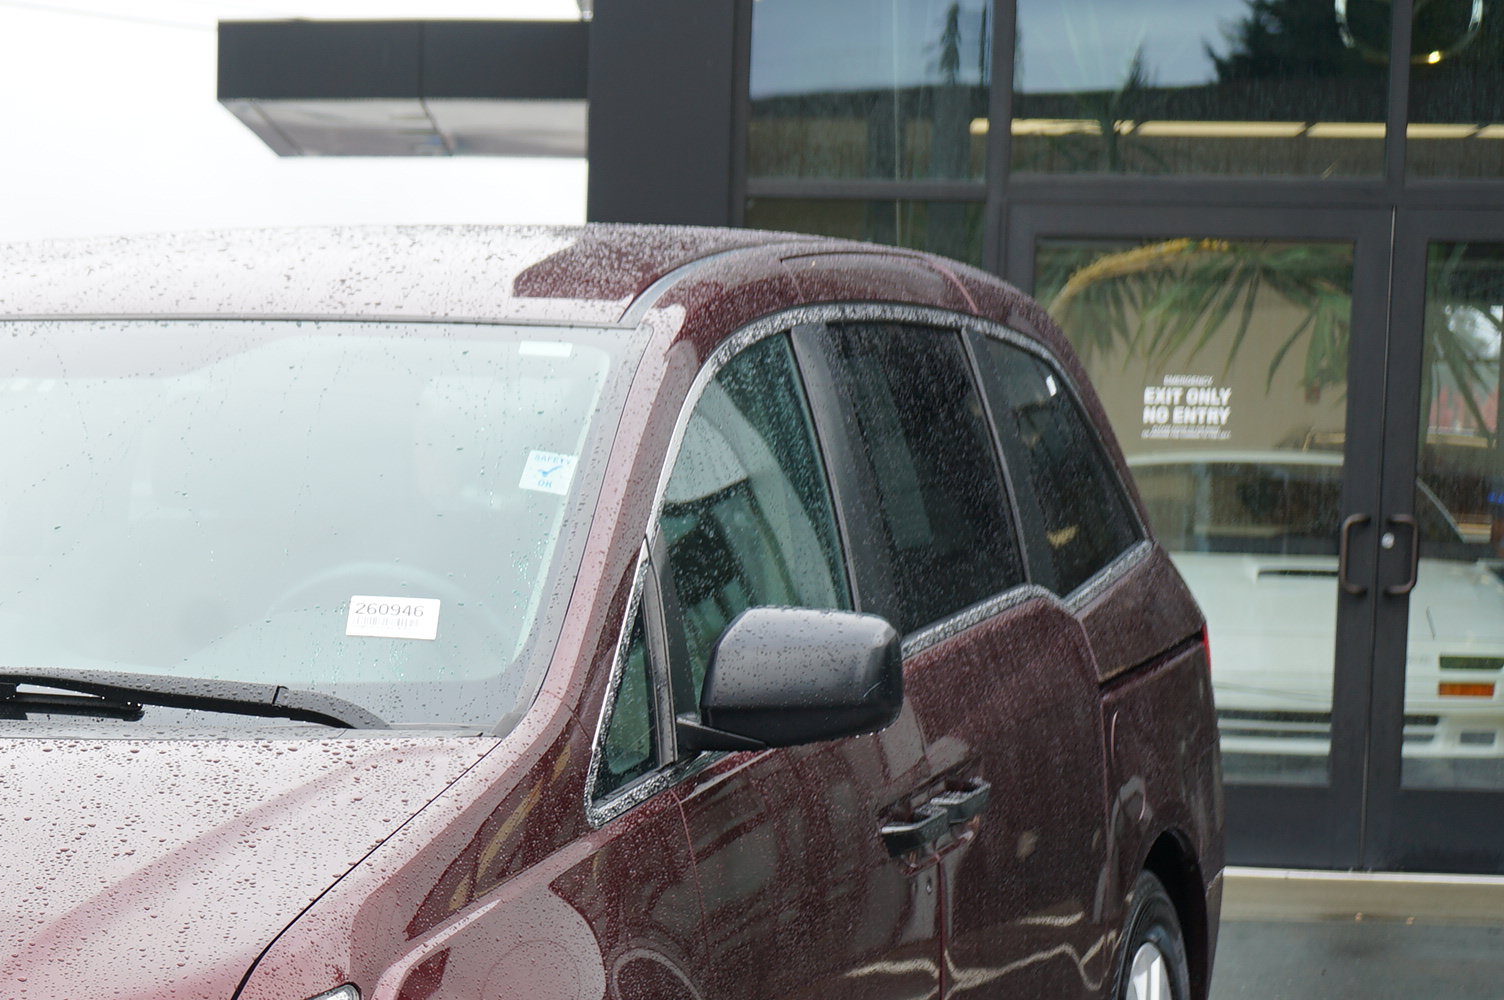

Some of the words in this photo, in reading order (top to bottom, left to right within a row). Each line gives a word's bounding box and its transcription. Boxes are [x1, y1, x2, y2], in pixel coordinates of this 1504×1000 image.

[1144, 386, 1183, 405] EXIT
[1186, 387, 1231, 406] ONLY
[1142, 406, 1169, 424] NO
[1172, 406, 1231, 425] ENTRY
[354, 602, 424, 618] 260946
